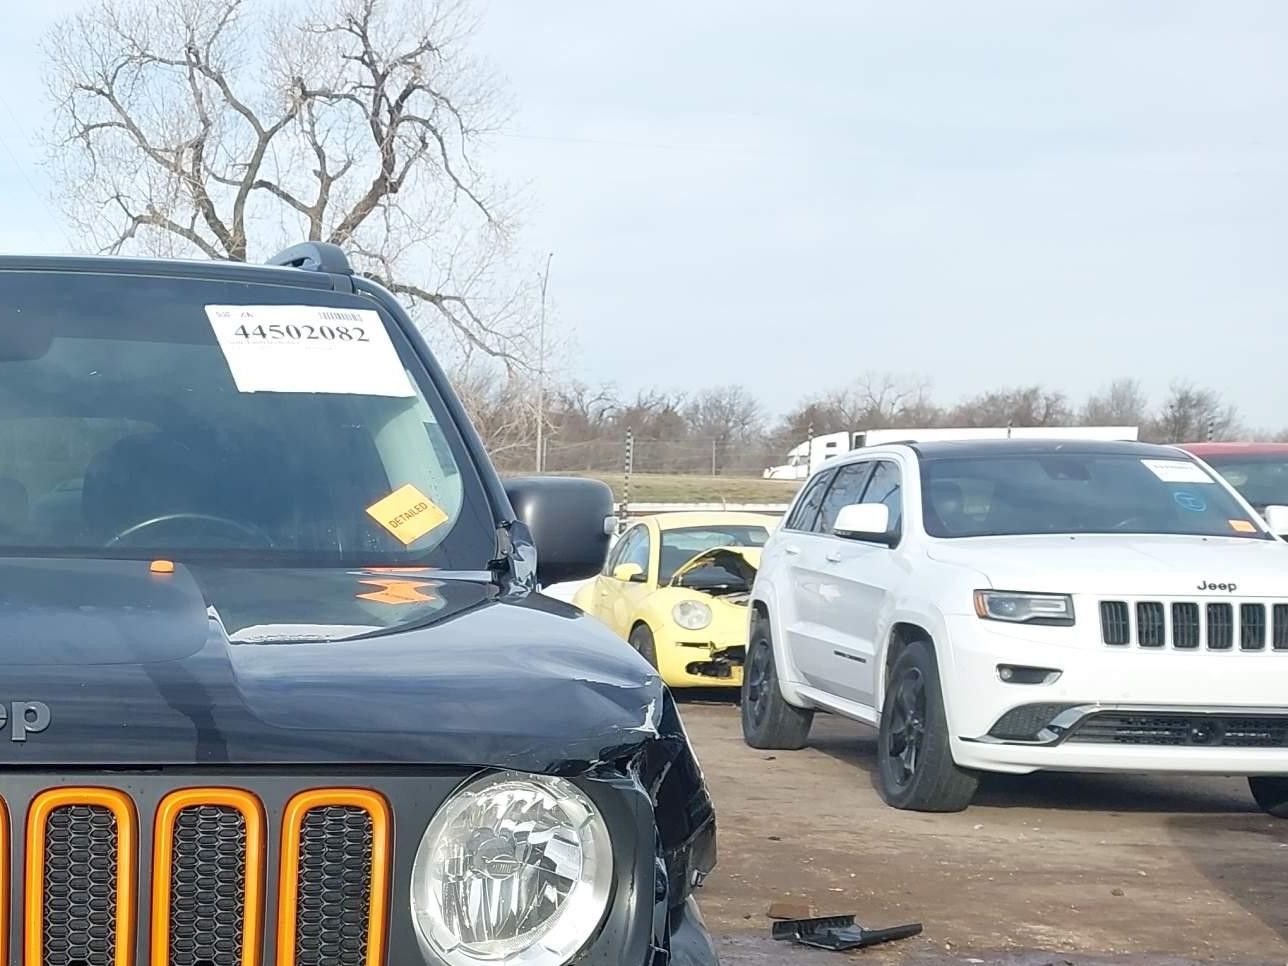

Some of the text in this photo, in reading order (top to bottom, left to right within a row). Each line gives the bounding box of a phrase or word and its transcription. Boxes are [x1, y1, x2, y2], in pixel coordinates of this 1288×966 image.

[233, 323, 371, 343] 44502082
[388, 502, 428, 529] DETAILED
[1196, 580, 1238, 593] Jeep
